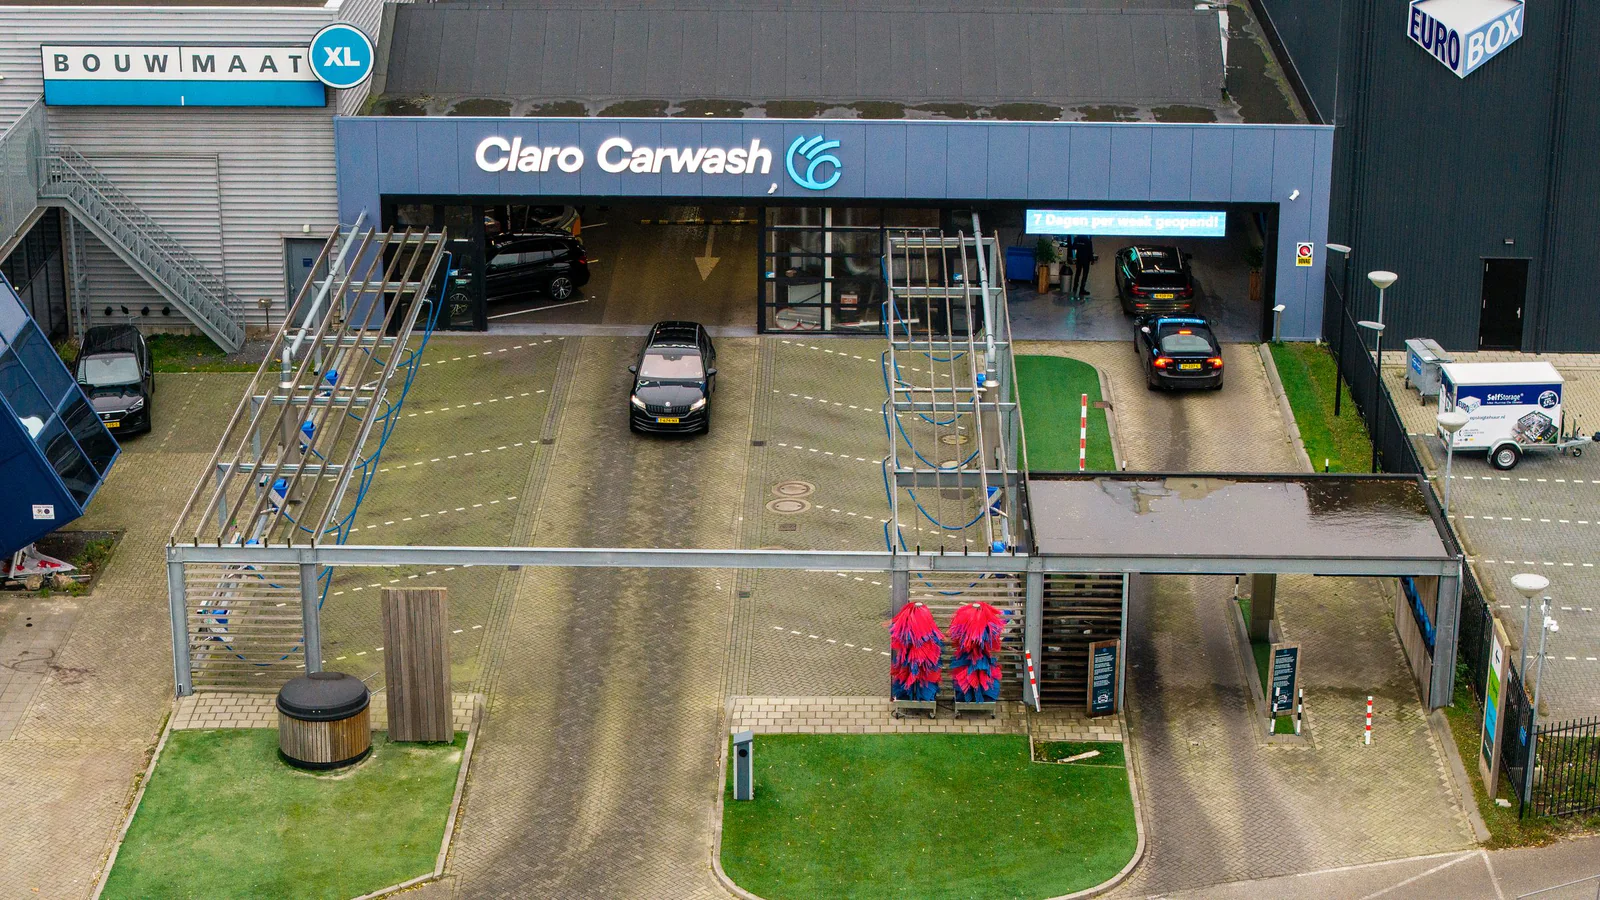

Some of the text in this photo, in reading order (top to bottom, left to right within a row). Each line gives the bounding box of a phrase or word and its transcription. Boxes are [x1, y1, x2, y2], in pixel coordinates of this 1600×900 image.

[1410, 6, 1460, 71] EURO
[1467, 8, 1521, 71] BOX
[54, 53, 303, 74] BOUW MAAT
[323, 46, 360, 67] XL
[475, 136, 772, 175] Claro Carwash
[1033, 213, 1219, 231] 7 Dagen per week geopend!
